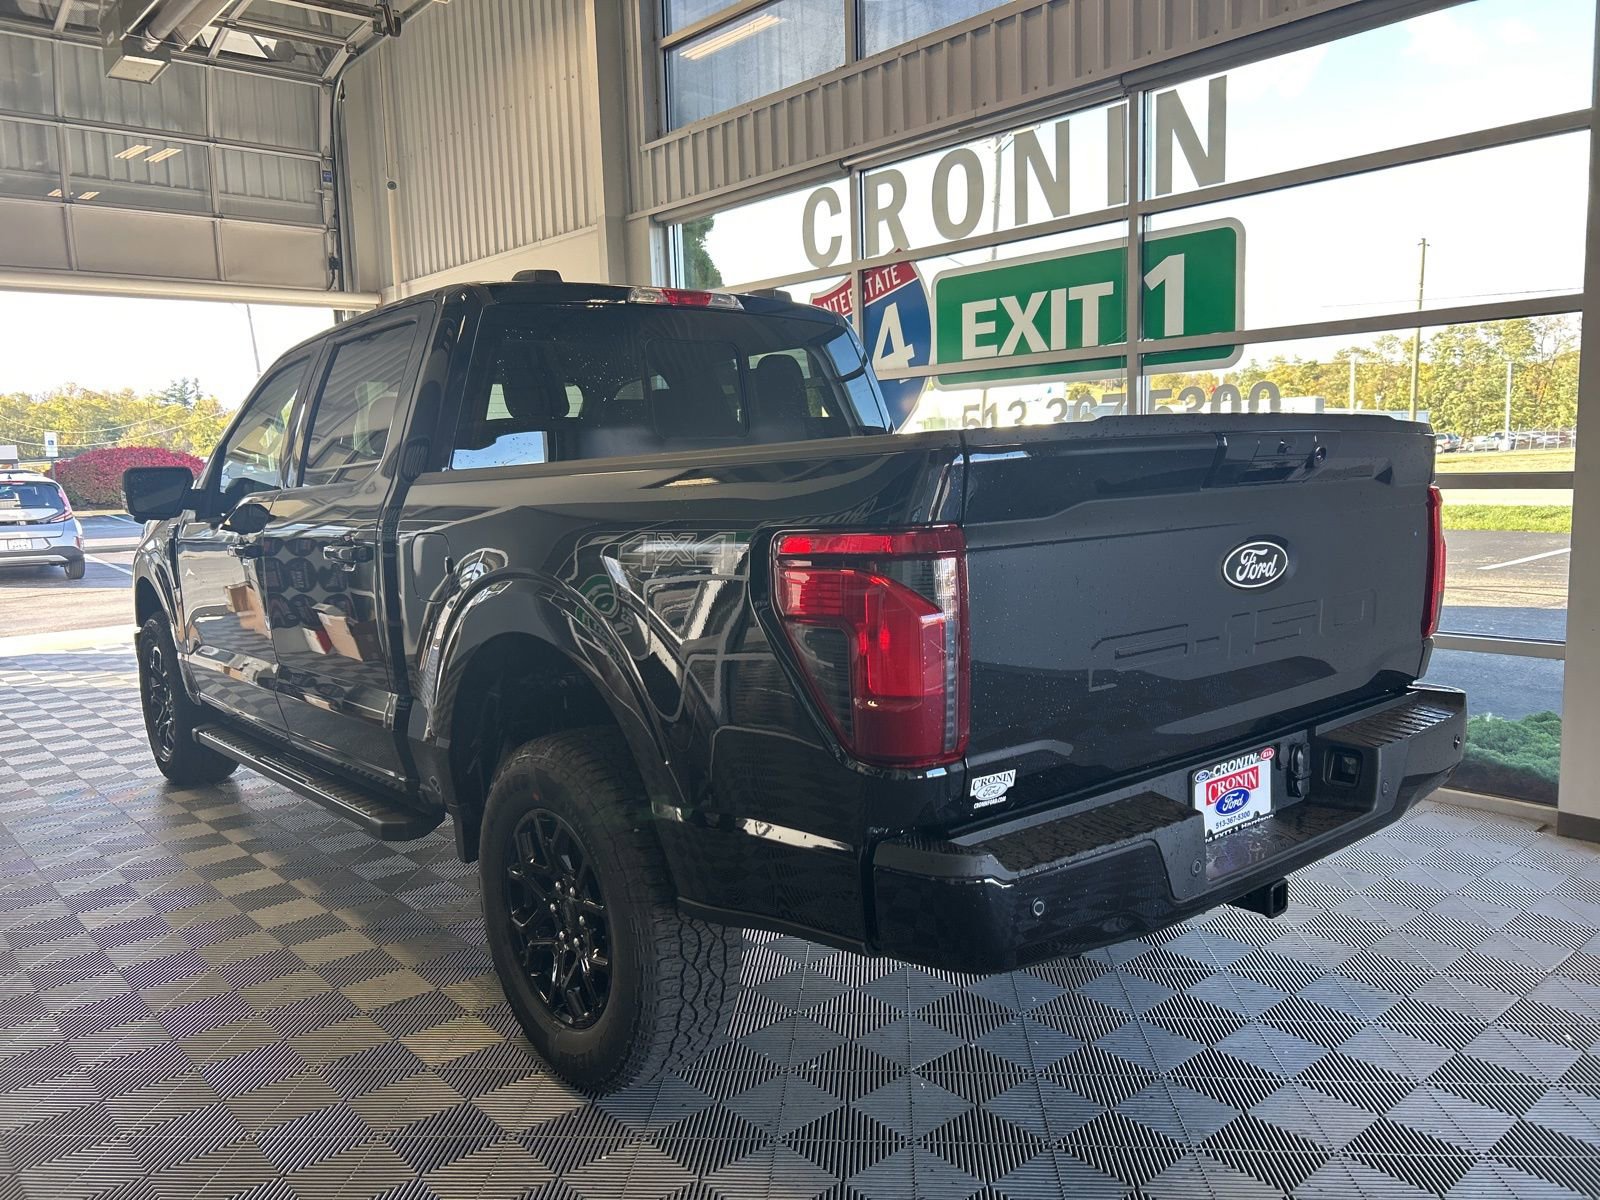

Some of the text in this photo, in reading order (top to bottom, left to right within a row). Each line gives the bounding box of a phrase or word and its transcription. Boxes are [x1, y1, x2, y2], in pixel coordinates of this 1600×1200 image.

[802, 75, 1227, 268] CRONIN
[819, 265, 901, 313] NTETATE
[962, 254, 1184, 359] EXIT 1
[1236, 548, 1278, 581] Ford
[973, 771, 1014, 790] CRONIN
[1208, 769, 1257, 802] CRONIN
[1222, 792, 1245, 811] Ford
[1216, 811, 1250, 829] 513-367-5300
